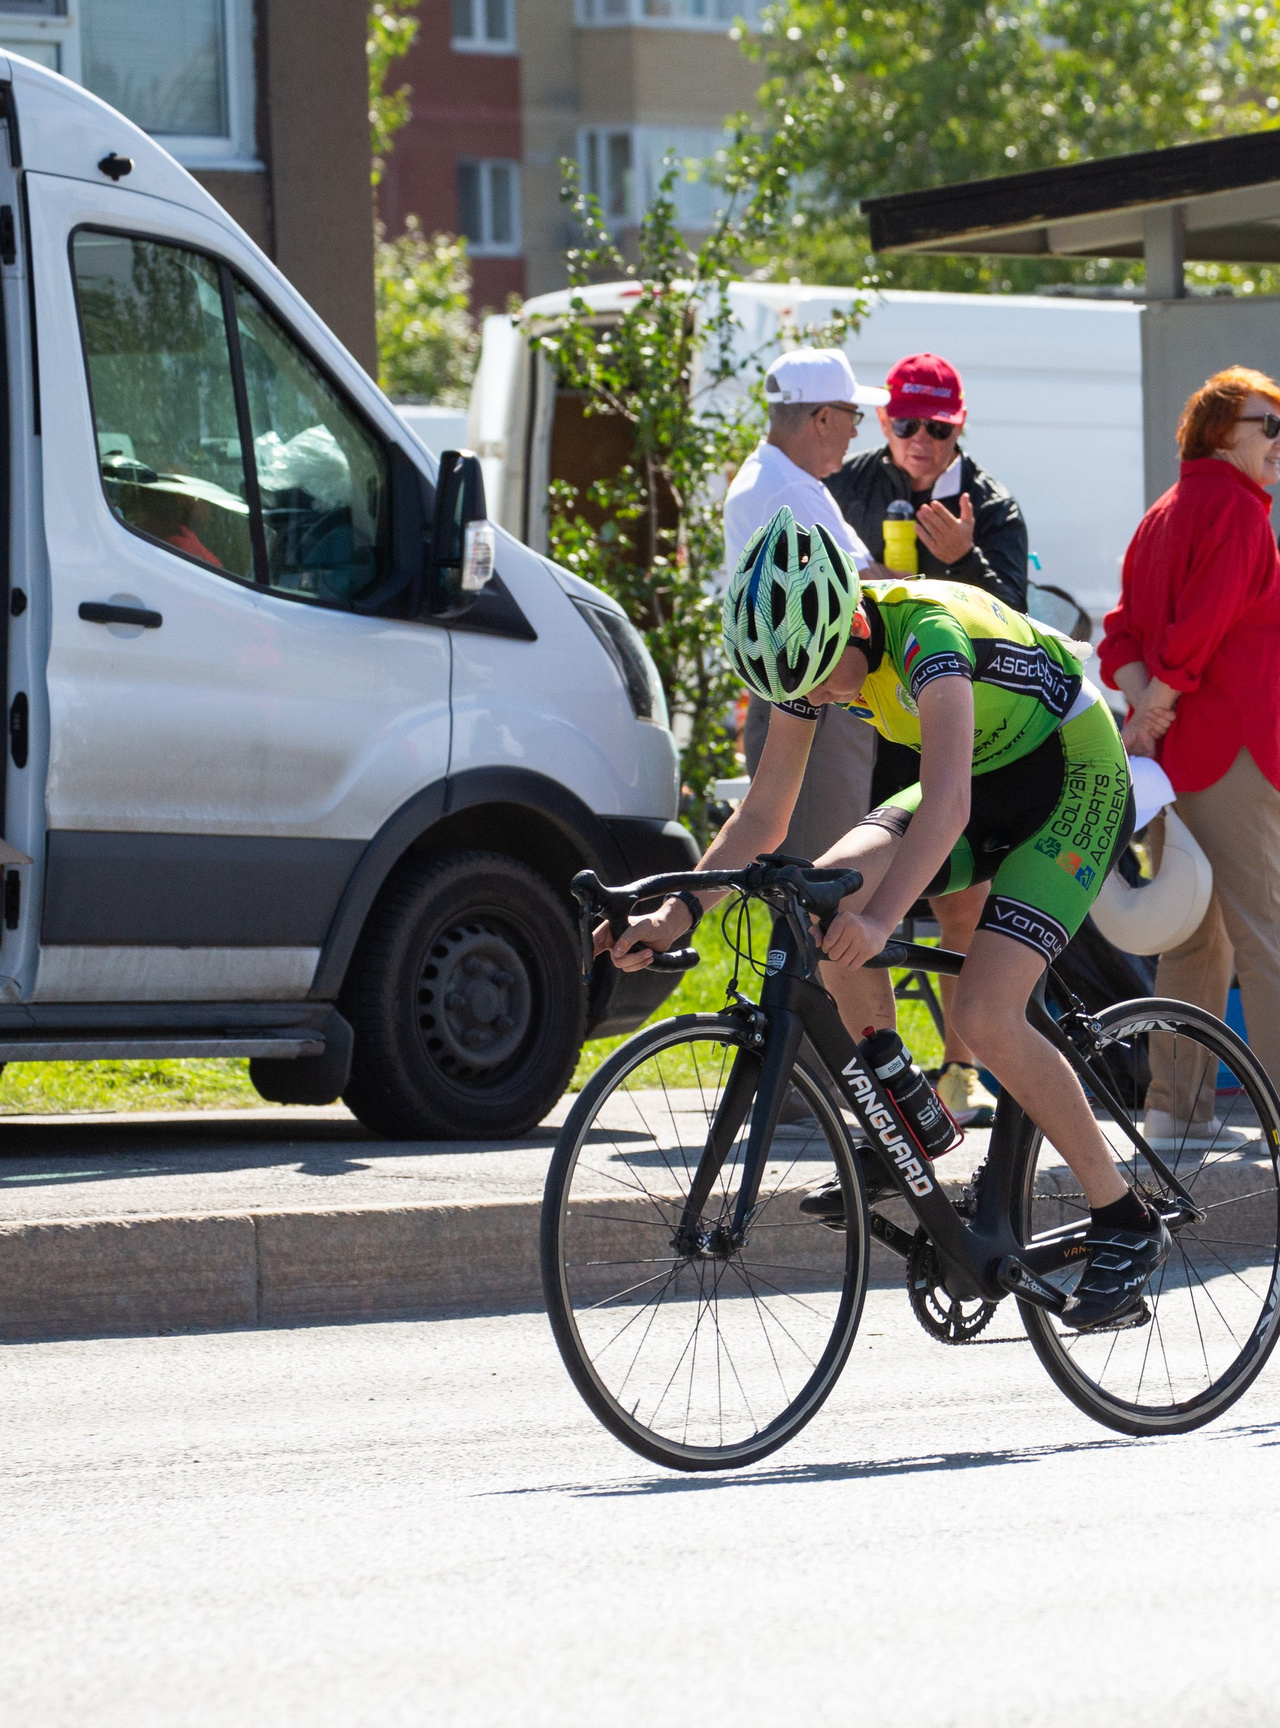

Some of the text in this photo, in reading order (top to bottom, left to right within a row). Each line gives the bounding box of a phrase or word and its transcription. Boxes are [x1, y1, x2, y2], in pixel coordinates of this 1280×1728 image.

[1051, 762, 1087, 838] GOLYBIN
[1072, 773, 1110, 851] SPORTS
[1089, 762, 1127, 867] ACADEMY
[994, 904, 1063, 956] Vangu
[841, 1056, 934, 1198] VANGUARD
